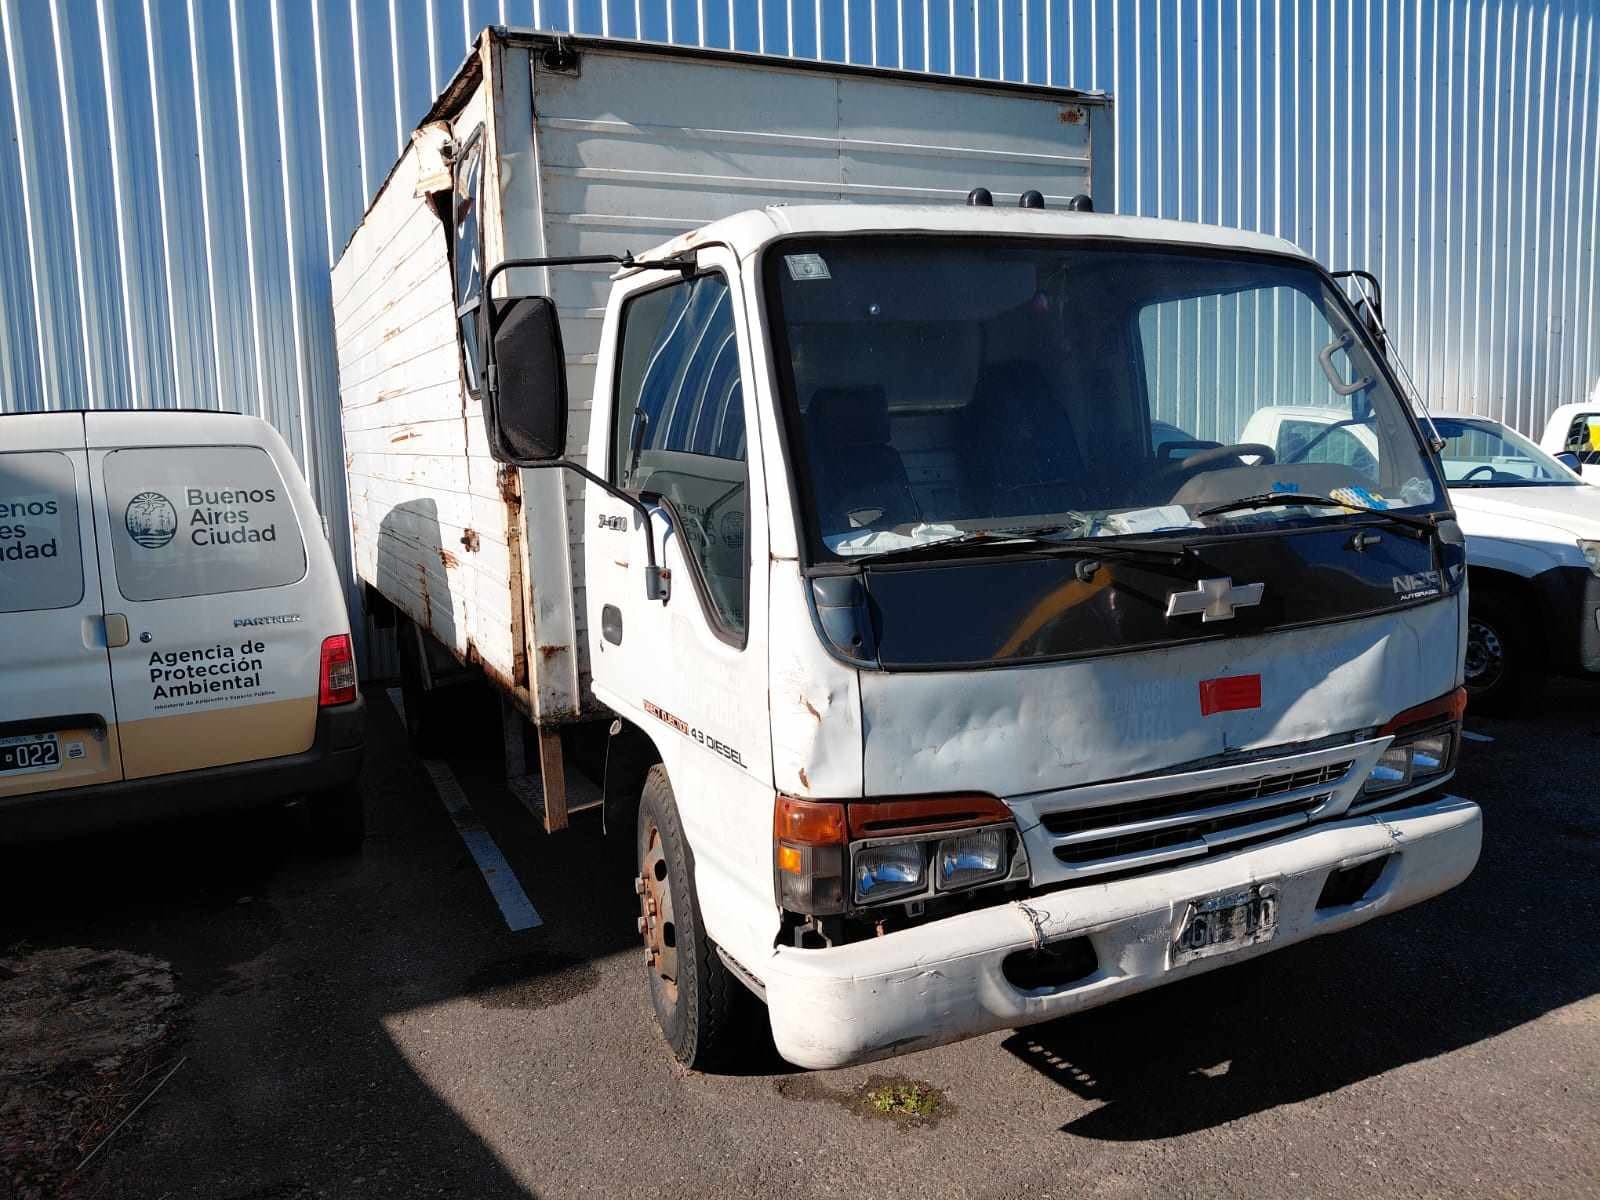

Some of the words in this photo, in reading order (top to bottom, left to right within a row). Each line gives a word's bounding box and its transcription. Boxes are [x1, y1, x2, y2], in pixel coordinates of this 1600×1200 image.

[187, 488, 276, 506] Buenos
[190, 508, 249, 526] Aires
[191, 524, 276, 547] Ciudad
[233, 614, 302, 628] PARTNER
[149, 645, 234, 667] Agencia
[240, 640, 265, 655] de
[150, 657, 263, 683] Protección
[153, 673, 260, 700] Ambiental
[706, 735, 748, 769] DIESEL
